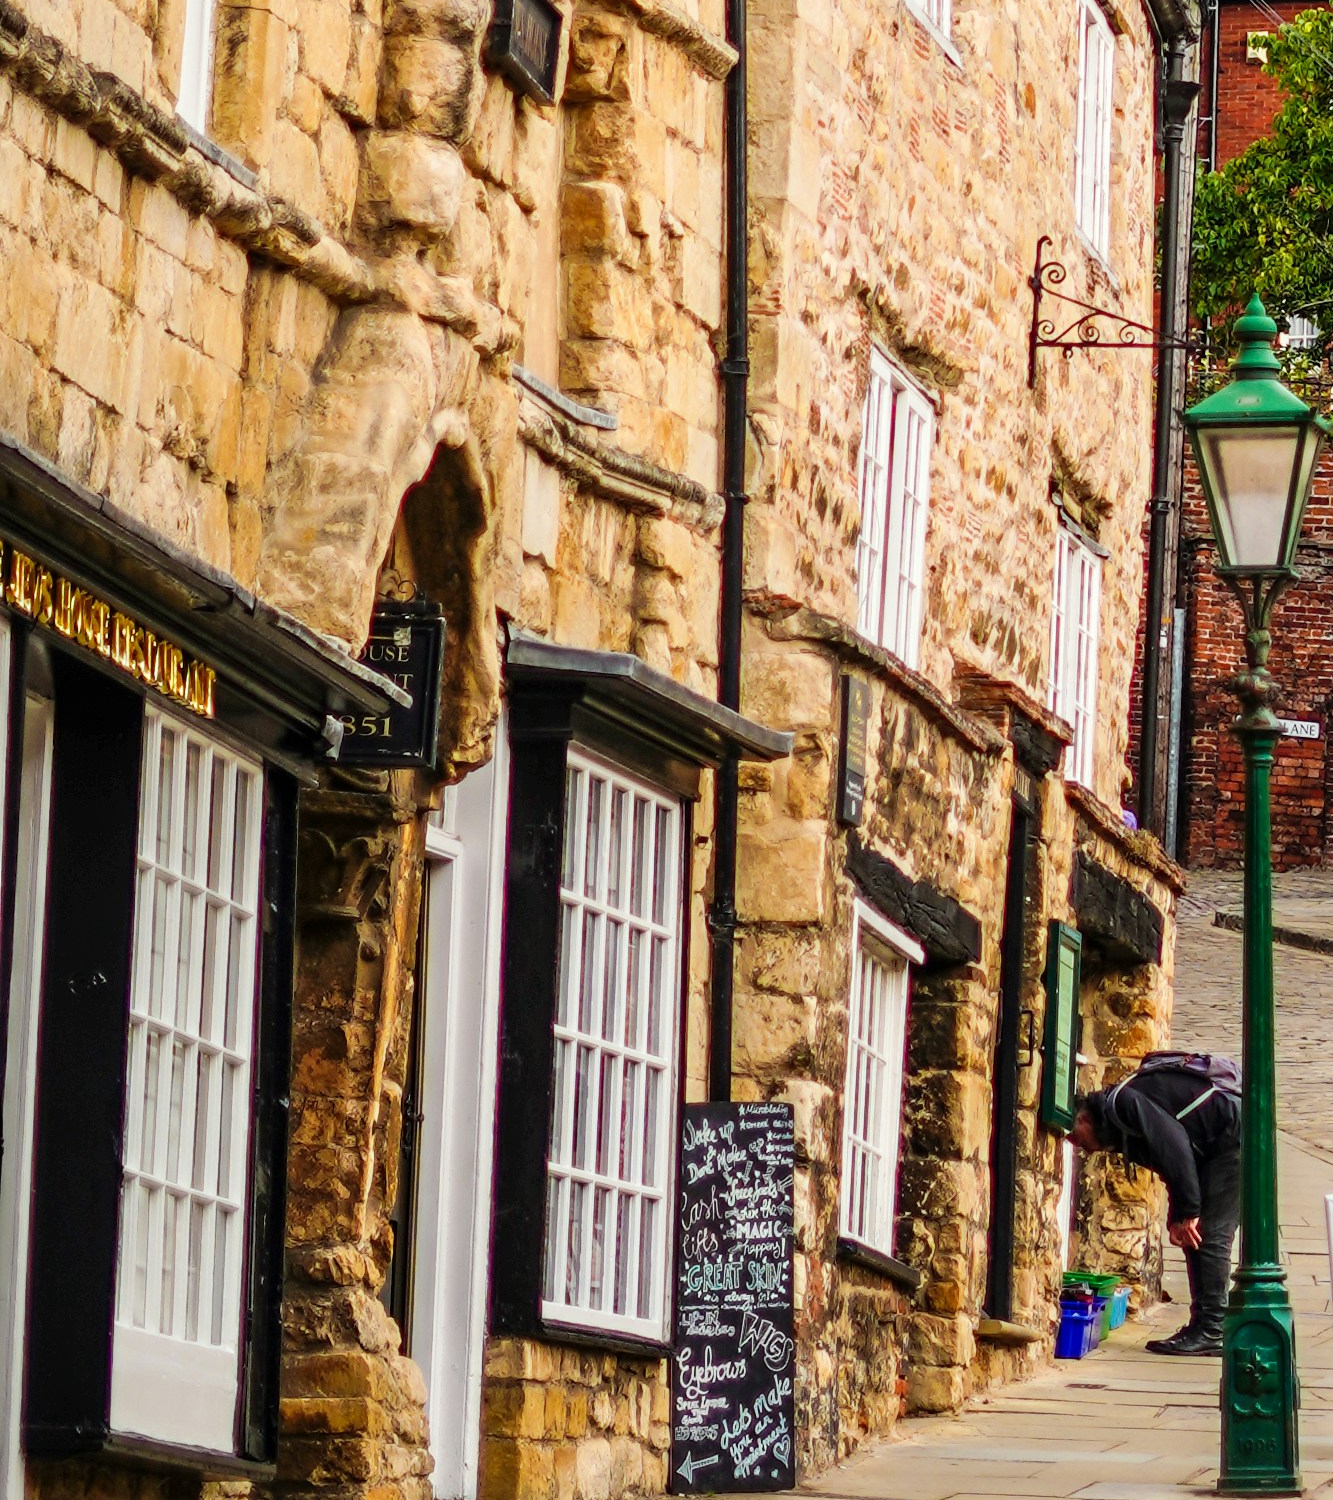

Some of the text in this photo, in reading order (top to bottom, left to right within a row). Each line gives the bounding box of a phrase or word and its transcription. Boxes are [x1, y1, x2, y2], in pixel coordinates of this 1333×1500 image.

[361, 645, 410, 663] USE
[338, 715, 392, 737] 851
[736, 1220, 783, 1239] MAGIC
[687, 1260, 783, 1292] GREAT SKIN
[739, 1310, 794, 1372] WIGS
[676, 1345, 747, 1400] Eyebrows
